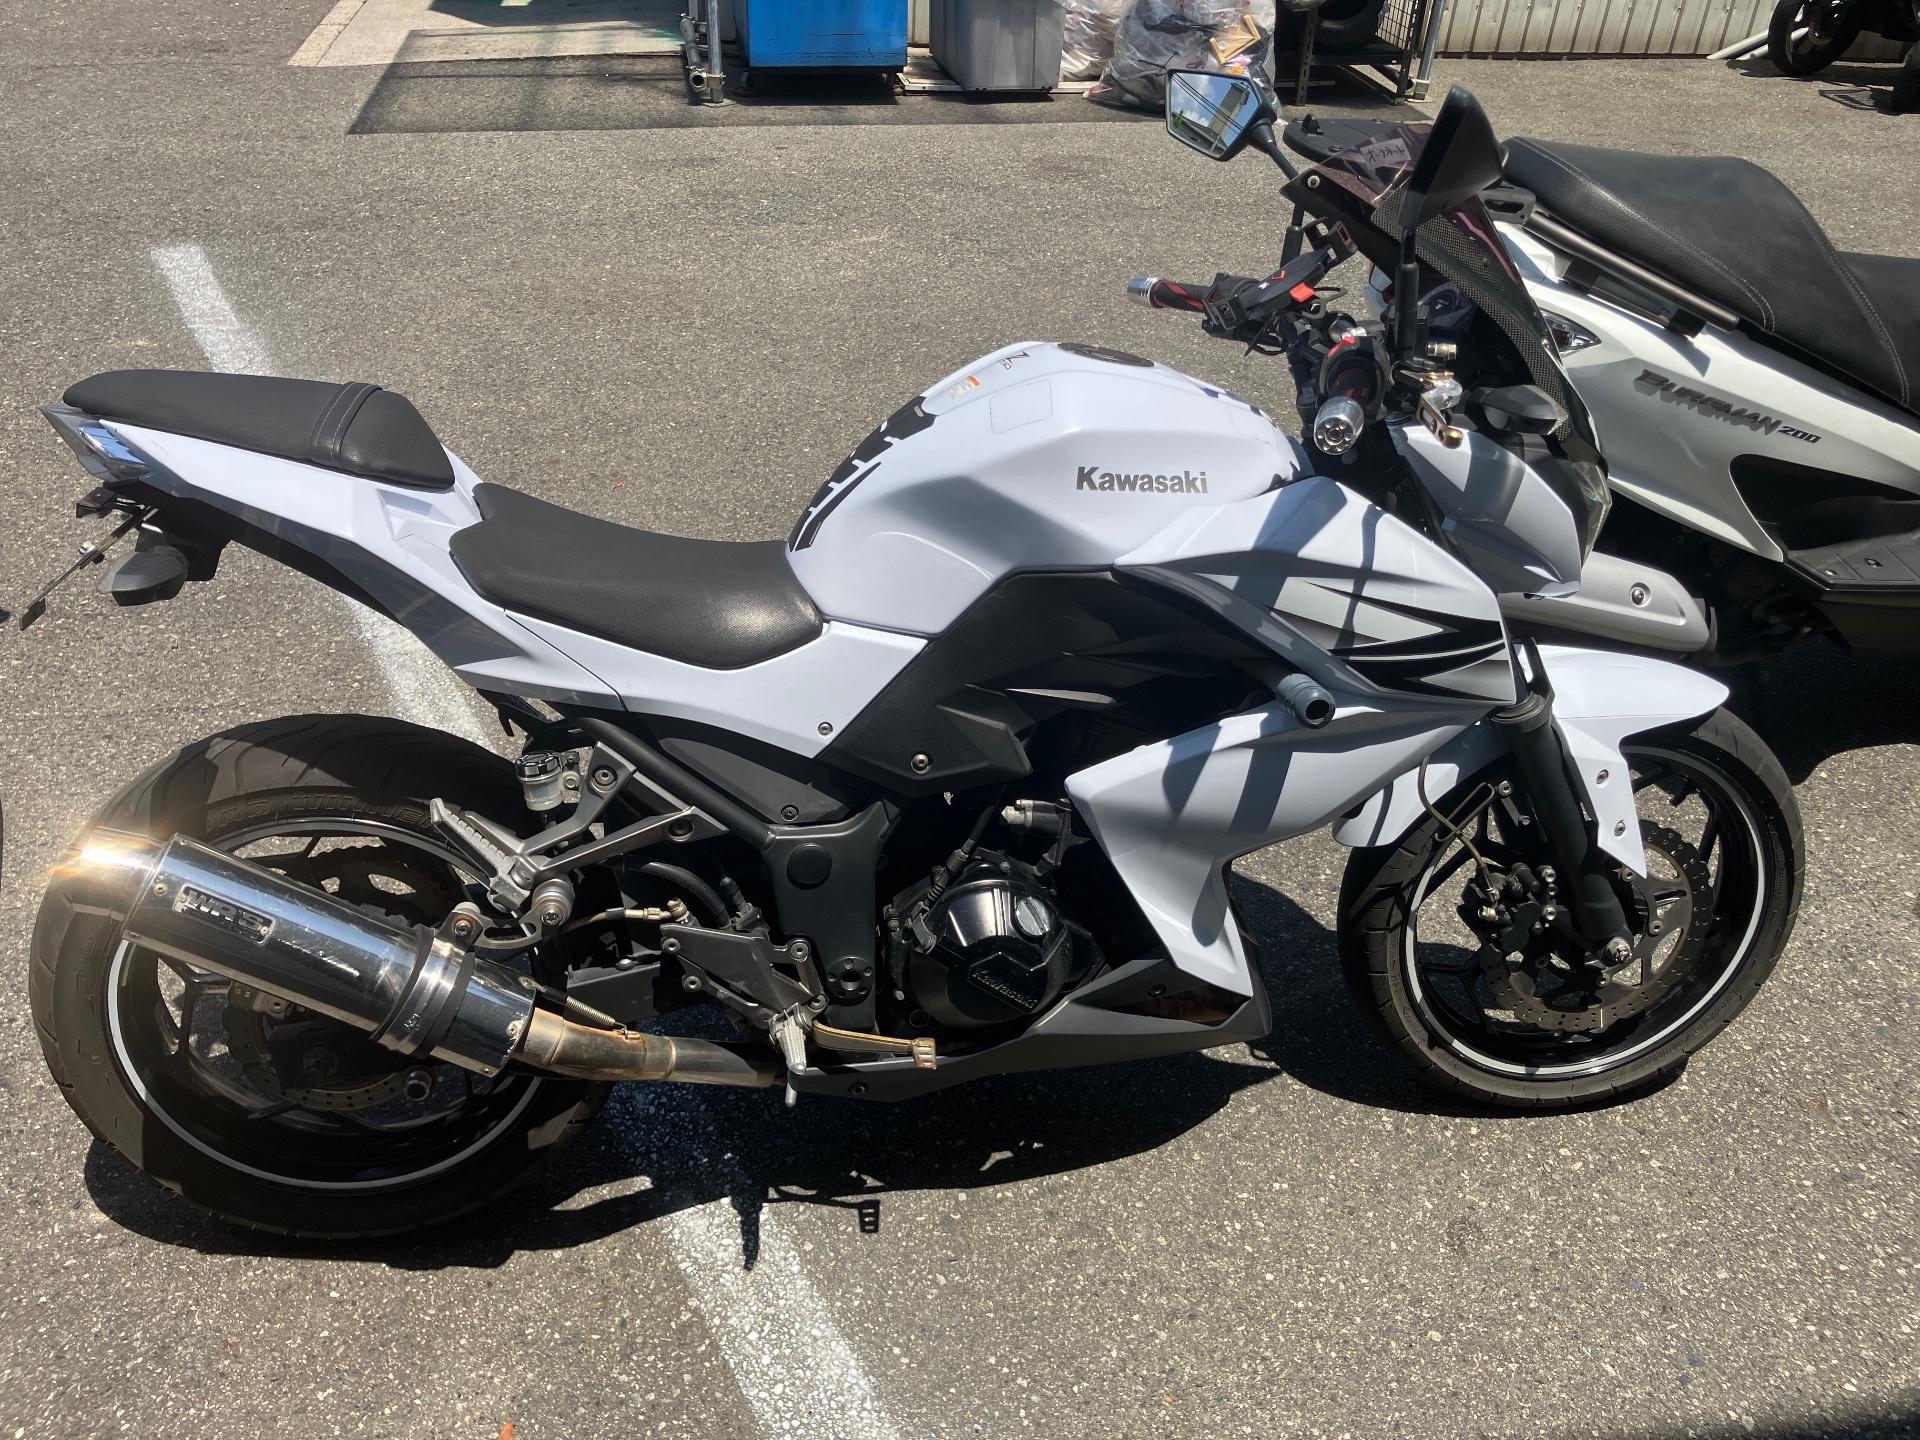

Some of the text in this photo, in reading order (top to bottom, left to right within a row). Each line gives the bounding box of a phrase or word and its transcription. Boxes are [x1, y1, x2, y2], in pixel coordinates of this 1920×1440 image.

[1633, 369, 1822, 444] BURGMAN 200
[1076, 466, 1208, 494] Kawasaki
[971, 968, 1038, 1009] Kawasaki
